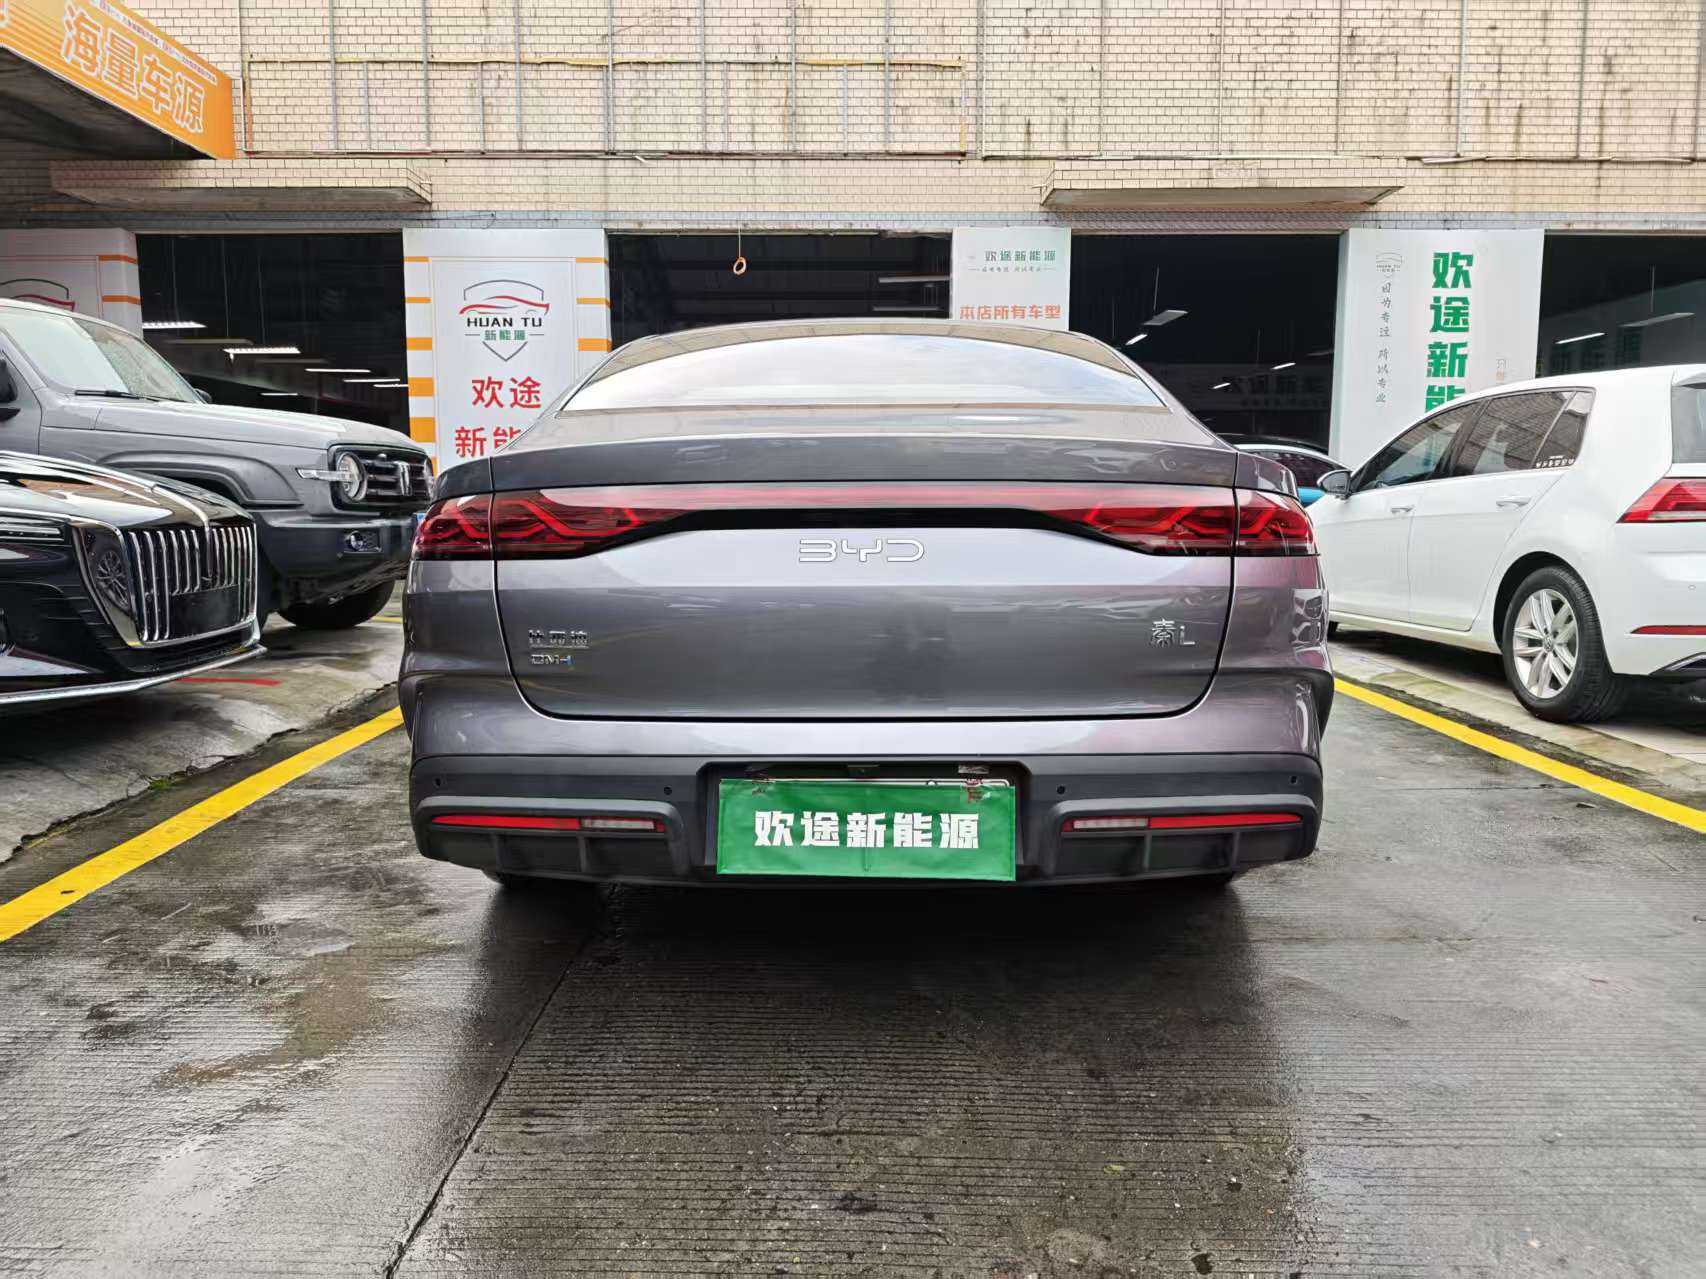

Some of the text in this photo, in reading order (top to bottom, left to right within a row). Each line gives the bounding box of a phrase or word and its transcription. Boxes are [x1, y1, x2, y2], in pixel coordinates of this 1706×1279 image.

[61, 2, 205, 133] 海量车源
[467, 317, 542, 327] HUAN TU
[960, 304, 1061, 320] 本店所有车型
[471, 376, 542, 409] 欢途
[799, 539, 925, 562] BYD
[754, 810, 979, 849] 欢途新能源
